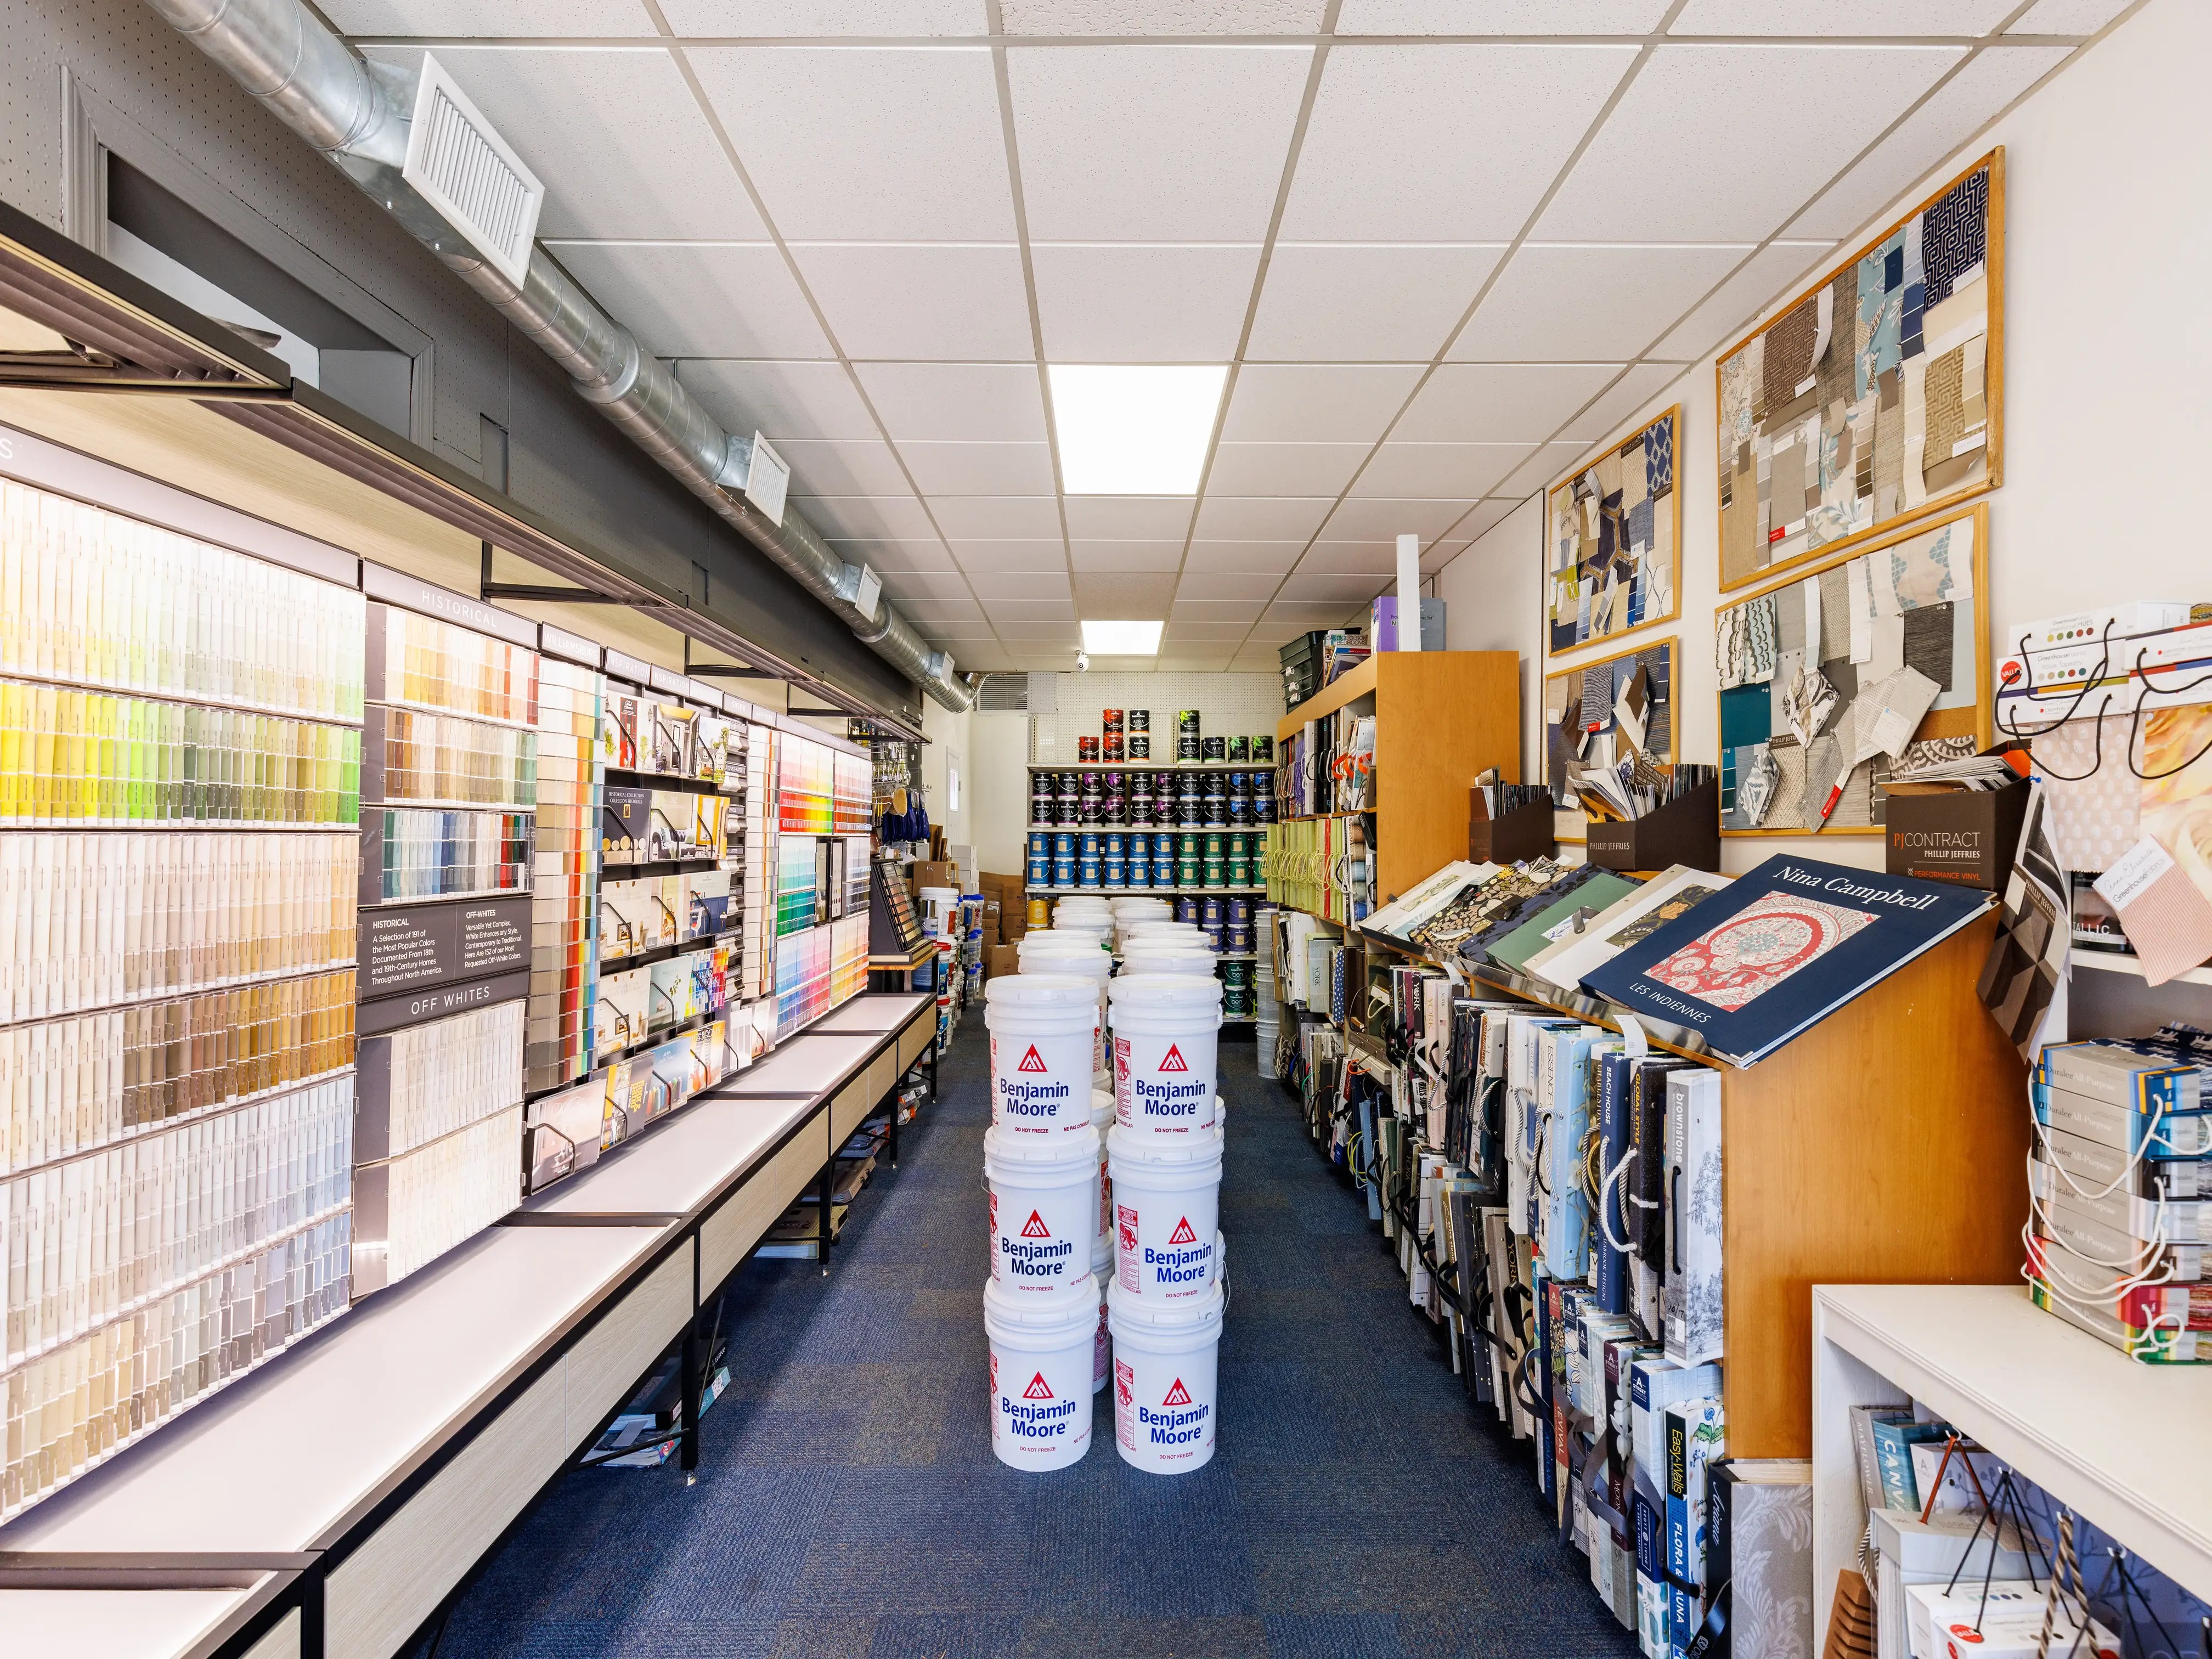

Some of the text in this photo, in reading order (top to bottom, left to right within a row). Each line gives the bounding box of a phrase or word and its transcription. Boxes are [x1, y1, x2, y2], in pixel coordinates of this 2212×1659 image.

[422, 590, 497, 628] HISTORICAL
[2078, 619, 2093, 628] HUES
[544, 631, 599, 660] WILLIAMSBURG
[607, 658, 650, 679] INSPIRATION
[653, 672, 690, 691] INSPIRATION
[731, 701, 746, 711] SHEEN
[1643, 762, 1653, 773] PHILLIP
[1590, 842, 1630, 851] PHILLIP JEFFRIES
[1950, 850, 1980, 859] JEFFRIES
[1914, 870, 1960, 879] PERFORMANCE
[1773, 866, 1939, 911] Nina Campbell
[2025, 878, 2057, 918] PHILLIP JEFFRIE
[466, 909, 495, 919] OFF-WHITES
[373, 918, 409, 929] HISTORICAL
[466, 923, 484, 931] Versatile
[2073, 922, 2110, 934] TALLIC
[379, 933, 404, 942] Selection
[465, 940, 495, 950] Contemporary
[501, 935, 522, 944] Traditional.
[372, 944, 382, 954] the
[383, 944, 397, 952] Most
[398, 941, 418, 950] Popular
[372, 952, 407, 964] Documented
[424, 948, 433, 956] 18th
[371, 966, 382, 975] and
[383, 962, 417, 974] 19th-Century
[465, 958, 488, 968] Requested
[488, 955, 508, 963] Off-White
[371, 967, 442, 985] Throughout North America.
[697, 970, 713, 979] COLOR
[411, 986, 489, 1014] OFF WHITES
[1629, 982, 1712, 1025] LES INDIENNES
[2045, 1065, 2114, 1092] Duralee All-Purpose
[1001, 1078, 1069, 1103] Benjamin
[1137, 1080, 1205, 1104] Benjamin
[2045, 1103, 2113, 1132] Duralee All-Purpose
[1676, 1093, 1684, 1163] brownstone
[2071, 1150, 2114, 1172] All-Purpose
[1002, 1237, 1071, 1262] Benjamin
[1146, 1243, 1211, 1270] Benjamin
[1508, 1243, 1517, 1282] YORK
[1605, 1359, 1618, 1369] STREET
[1609, 1353, 1614, 1363] A
[1633, 1384, 1646, 1395] STREET
[1637, 1377, 1643, 1387] A
[1002, 1397, 1075, 1426] Benjamin
[1140, 1404, 1208, 1432] Benjamin
[1670, 1429, 1684, 1494] Easy-Walls
[1857, 1421, 1874, 1494] MAYFLOWER
[1674, 1522, 1683, 1565] FLORA
[1675, 1568, 1683, 1577] &
